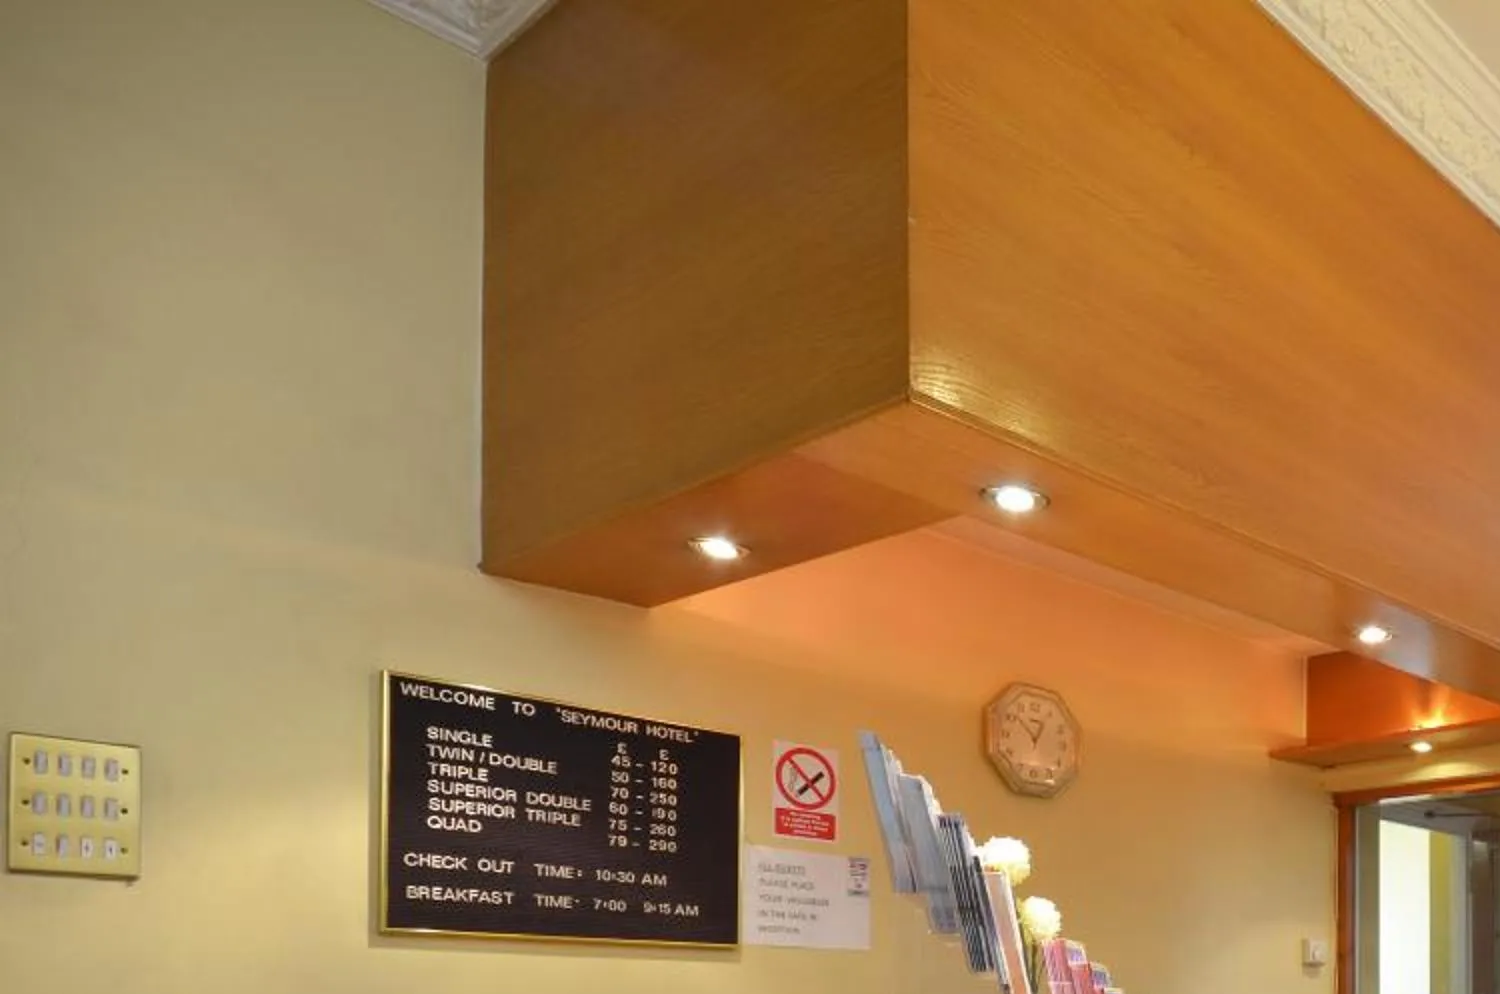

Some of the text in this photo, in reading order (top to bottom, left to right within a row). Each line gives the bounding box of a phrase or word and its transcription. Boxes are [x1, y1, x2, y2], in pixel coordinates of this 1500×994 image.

[400, 682, 496, 711] WELCOME
[512, 702, 536, 717] TO
[426, 743, 474, 762] TWIN
[489, 753, 558, 775] DOUBLE
[611, 771, 629, 783] 50
[427, 726, 493, 748] SINGLE
[611, 755, 631, 768] 45
[650, 760, 678, 775] 120
[427, 762, 489, 783] TRIPLE
[611, 786, 629, 799] 70
[427, 779, 517, 802] SUPERIOR
[525, 792, 592, 812] DOUBLE
[427, 815, 483, 833] QUAD
[428, 797, 515, 819] SUPERIOR
[525, 807, 582, 827] TRIPLE
[608, 818, 628, 831] 75
[403, 852, 468, 871] CHECK
[477, 857, 515, 875] OUT
[641, 873, 668, 886] AM
[405, 885, 515, 905] BREAKFAST
[674, 904, 699, 917] AM
